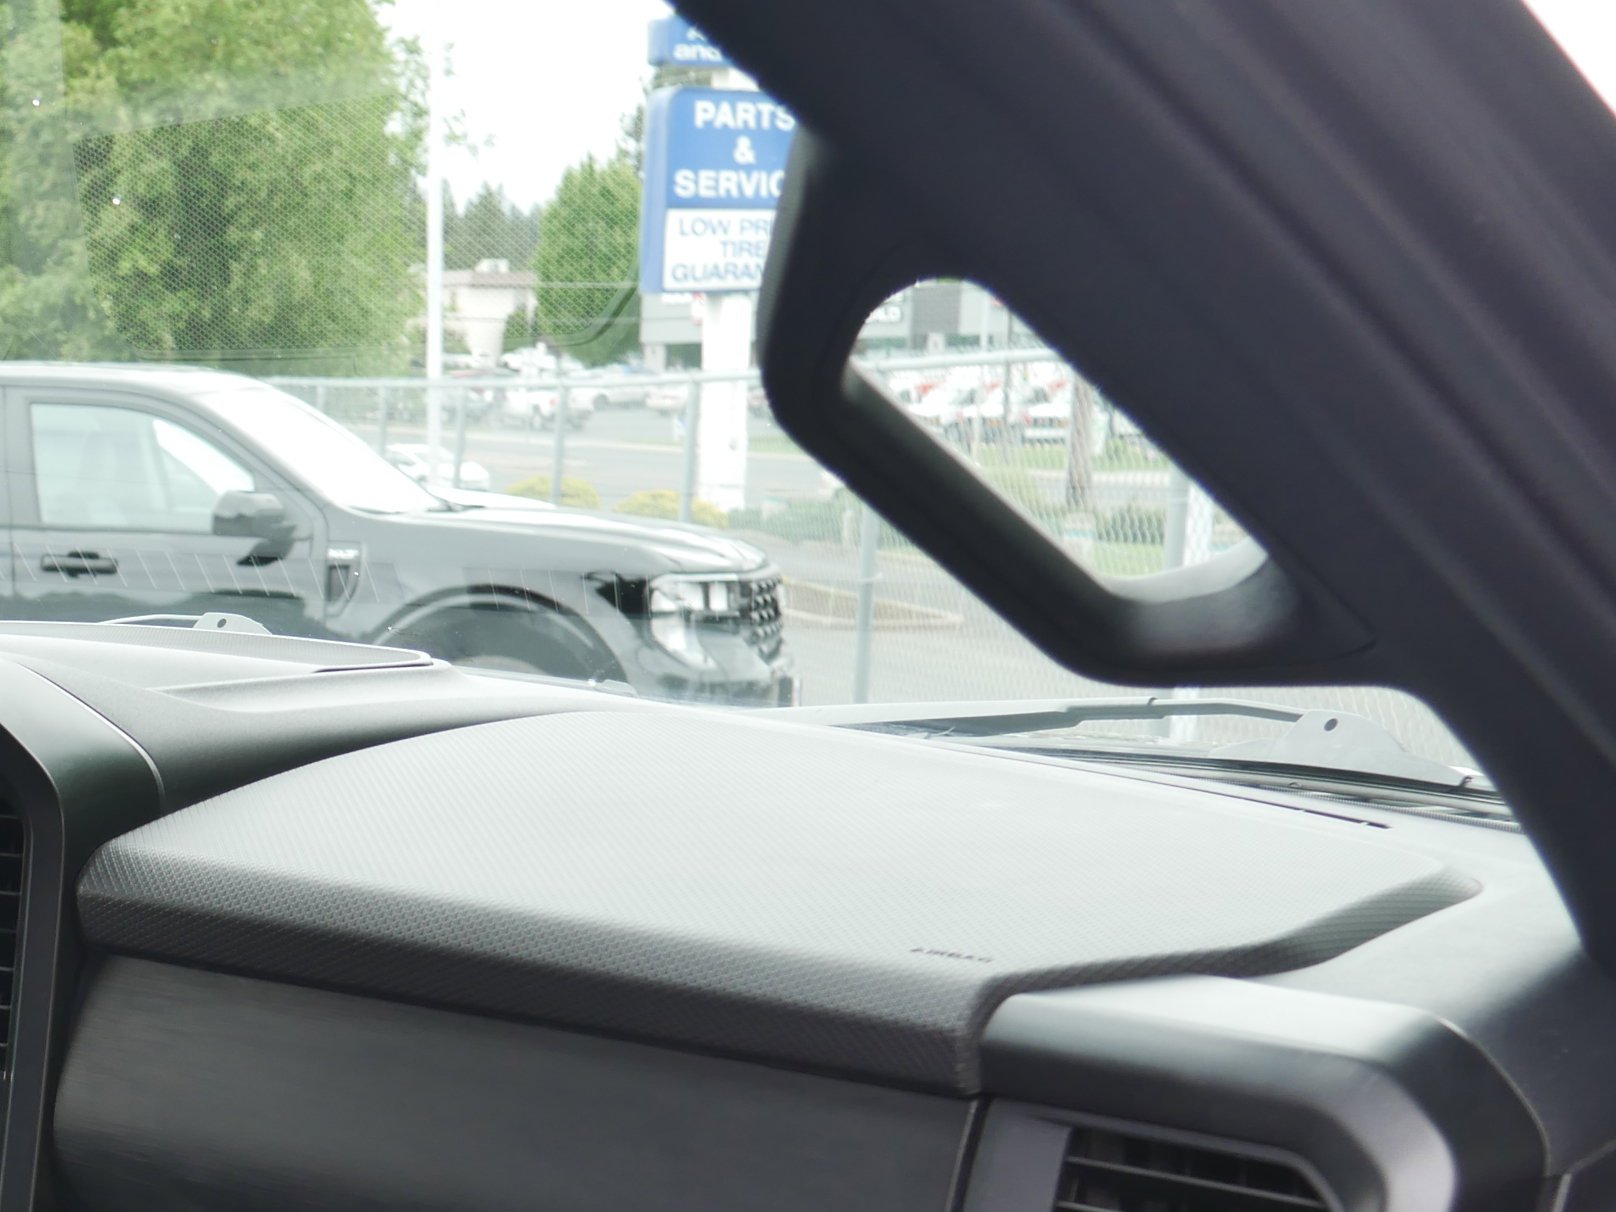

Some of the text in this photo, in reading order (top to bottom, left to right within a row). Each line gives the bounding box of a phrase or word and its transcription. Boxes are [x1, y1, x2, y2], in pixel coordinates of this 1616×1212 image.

[694, 100, 795, 132] PARTS
[733, 135, 756, 165] &
[679, 217, 731, 237] LOW
